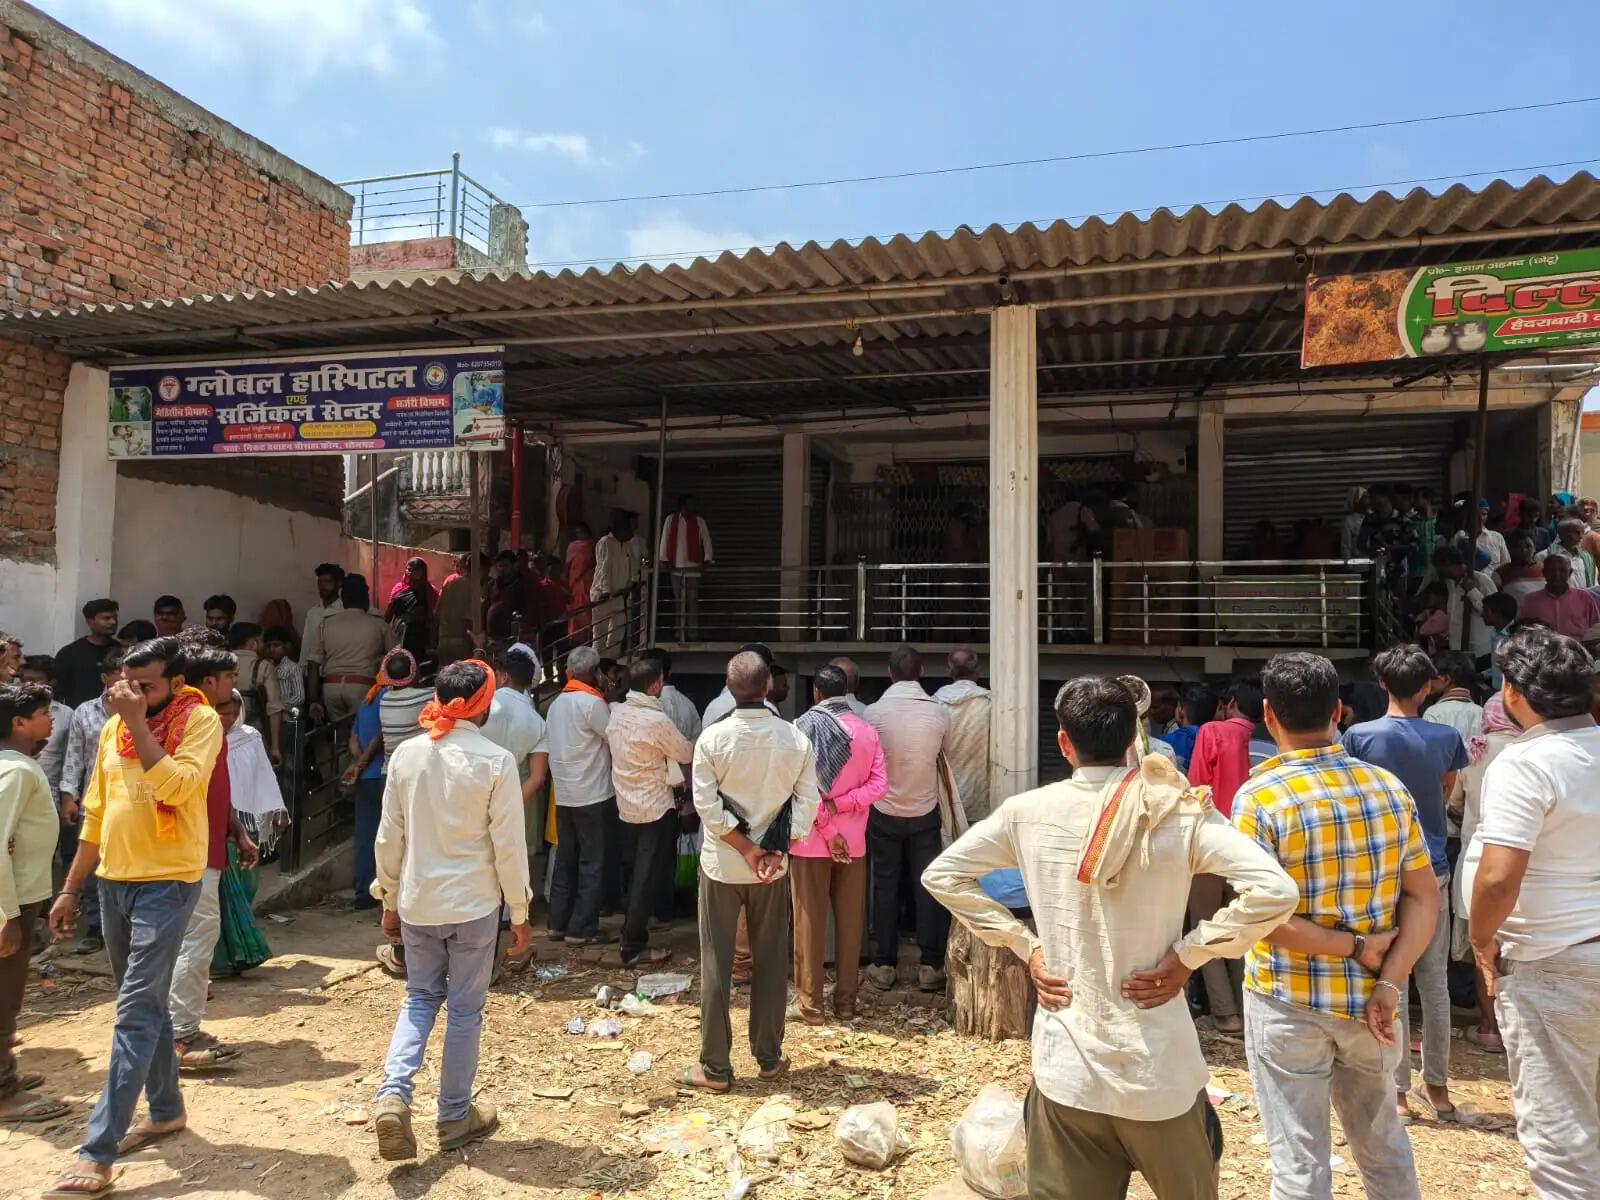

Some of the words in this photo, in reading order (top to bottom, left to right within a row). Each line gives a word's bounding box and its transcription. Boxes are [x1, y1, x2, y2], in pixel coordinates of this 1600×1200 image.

[184, 369, 285, 397] ग्लोबल
[215, 401, 316, 425] सर्जिकल
[319, 399, 384, 422] सेन्टर
